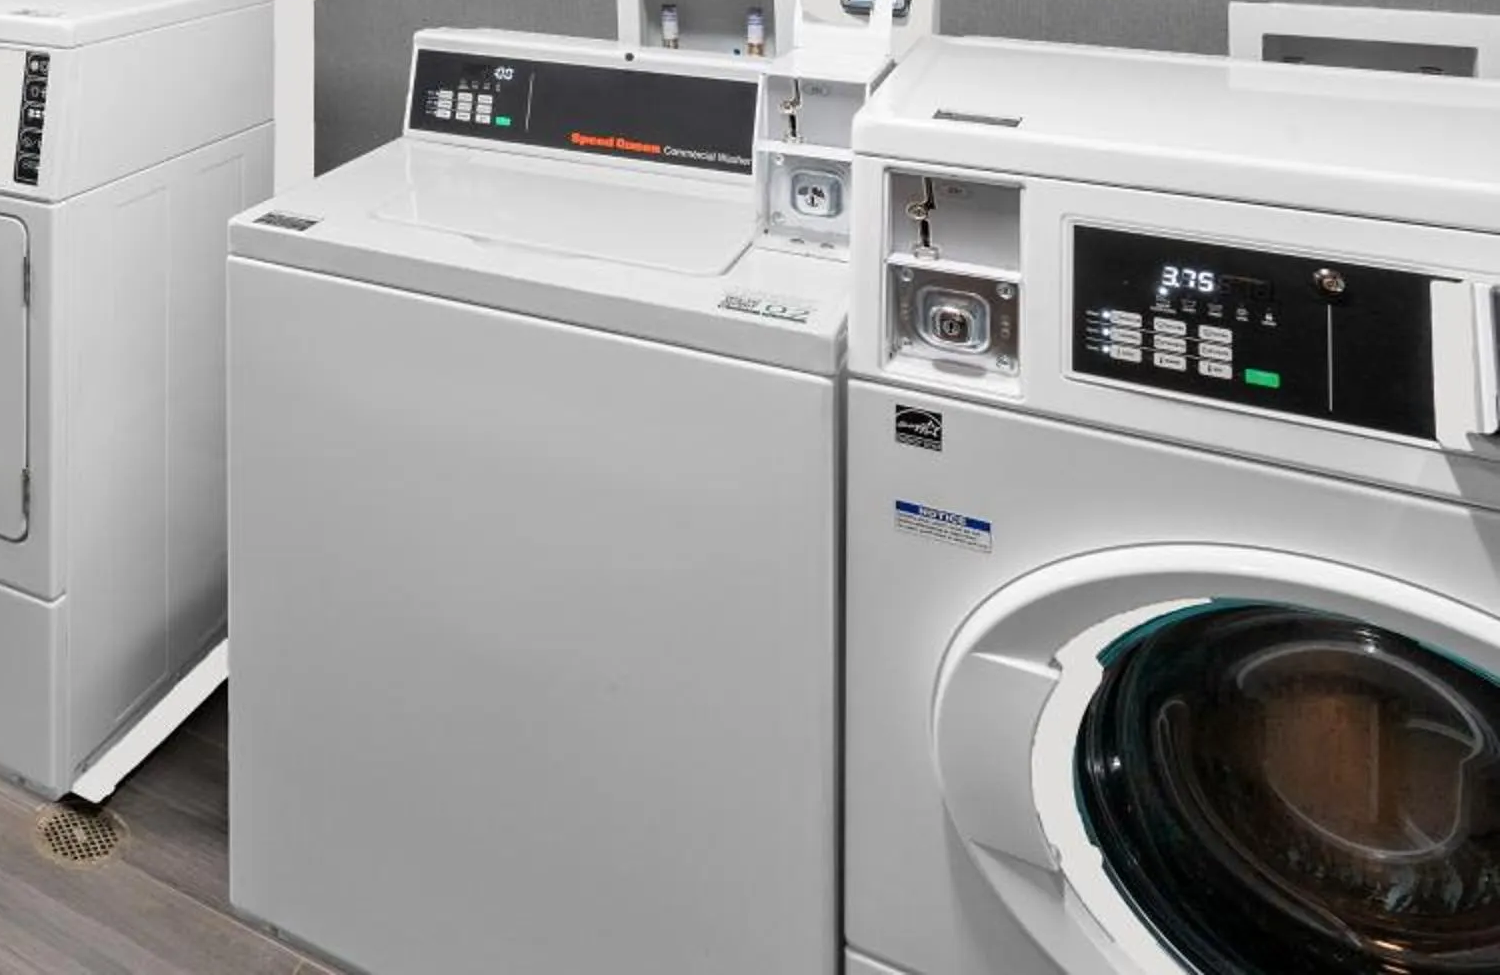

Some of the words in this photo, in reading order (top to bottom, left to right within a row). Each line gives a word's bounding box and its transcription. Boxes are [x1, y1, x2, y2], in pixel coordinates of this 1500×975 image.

[570, 131, 615, 148] Speed
[616, 138, 661, 155] Queen
[663, 145, 717, 163] Commercial
[918, 504, 966, 526] NOTICE
